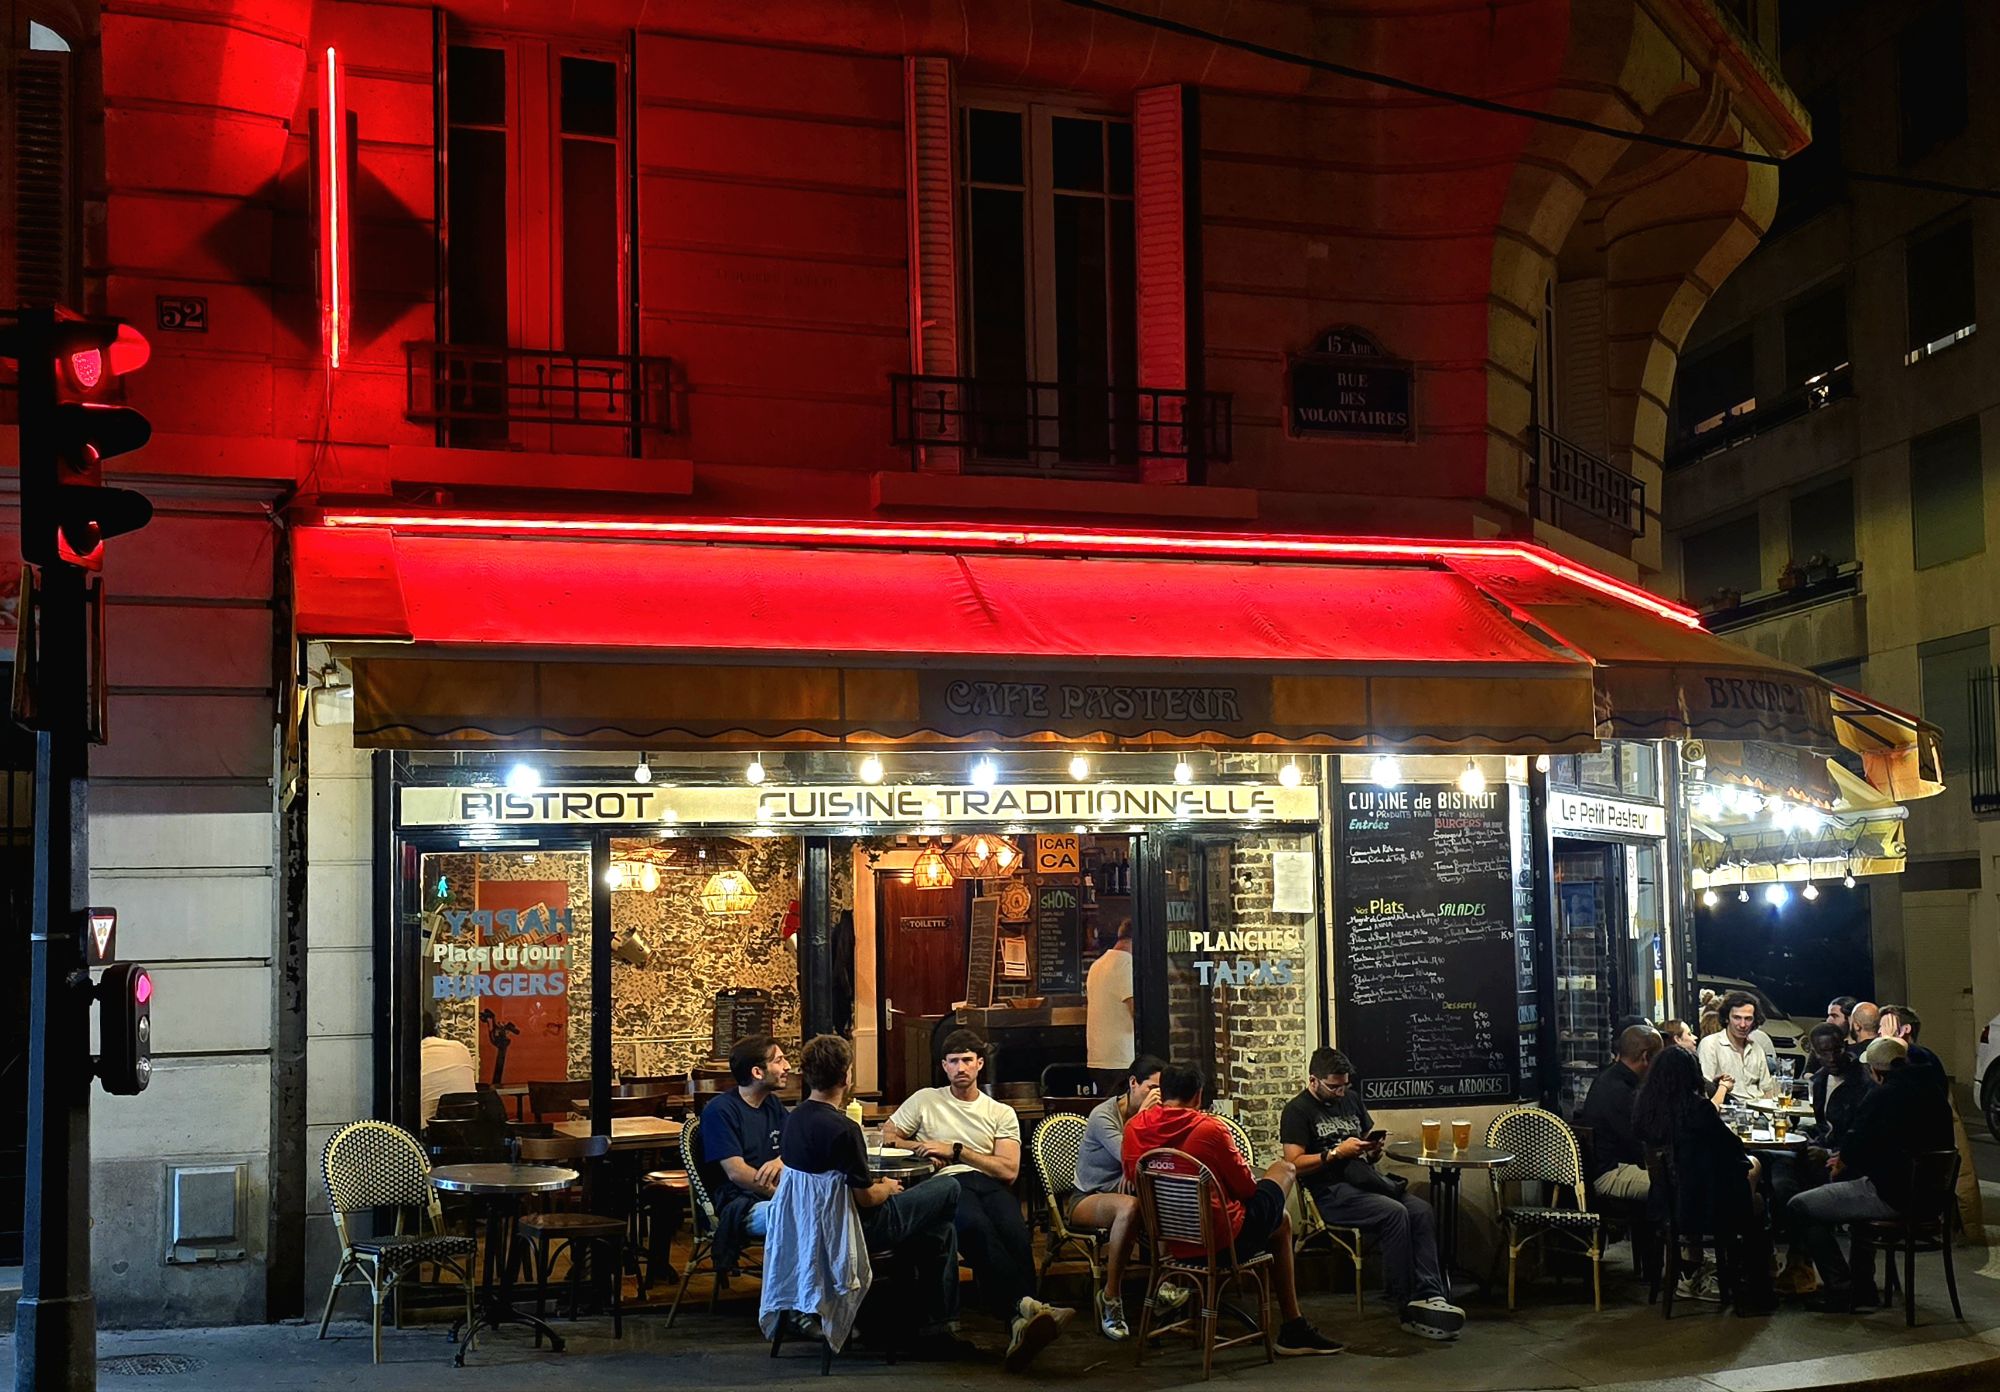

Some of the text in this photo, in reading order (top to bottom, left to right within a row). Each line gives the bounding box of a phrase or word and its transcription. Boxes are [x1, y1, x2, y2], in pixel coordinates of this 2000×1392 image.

[163, 302, 203, 327] 52
[1337, 372, 1368, 387] RUE
[1340, 391, 1366, 405] DES
[1299, 408, 1408, 426] VOLONTAIRES
[1060, 684, 1242, 722] PASTEUR
[461, 789, 1275, 819] BISTROT CUISINE TRADITIONNELLE
[1348, 791, 1498, 810] CUISINE de BISTROT
[1434, 817, 1482, 829] BURGERS
[1561, 799, 1648, 830] Le Petit Pasteur
[1039, 838, 1076, 850] ICAR
[1040, 853, 1076, 868] CA
[1040, 889, 1077, 910] SHOTS
[1370, 898, 1405, 915] Plats
[1438, 903, 1487, 917] SALADES
[909, 920, 946, 929] TOILETTE
[1188, 930, 1299, 952] PLANCHES
[433, 942, 565, 966] Plats du jour
[1193, 959, 1293, 986] TAPAS
[432, 972, 565, 999] BURGERS
[1365, 1079, 1434, 1098] SUGGESTIONS
[1458, 1077, 1503, 1094] ARDOISES
